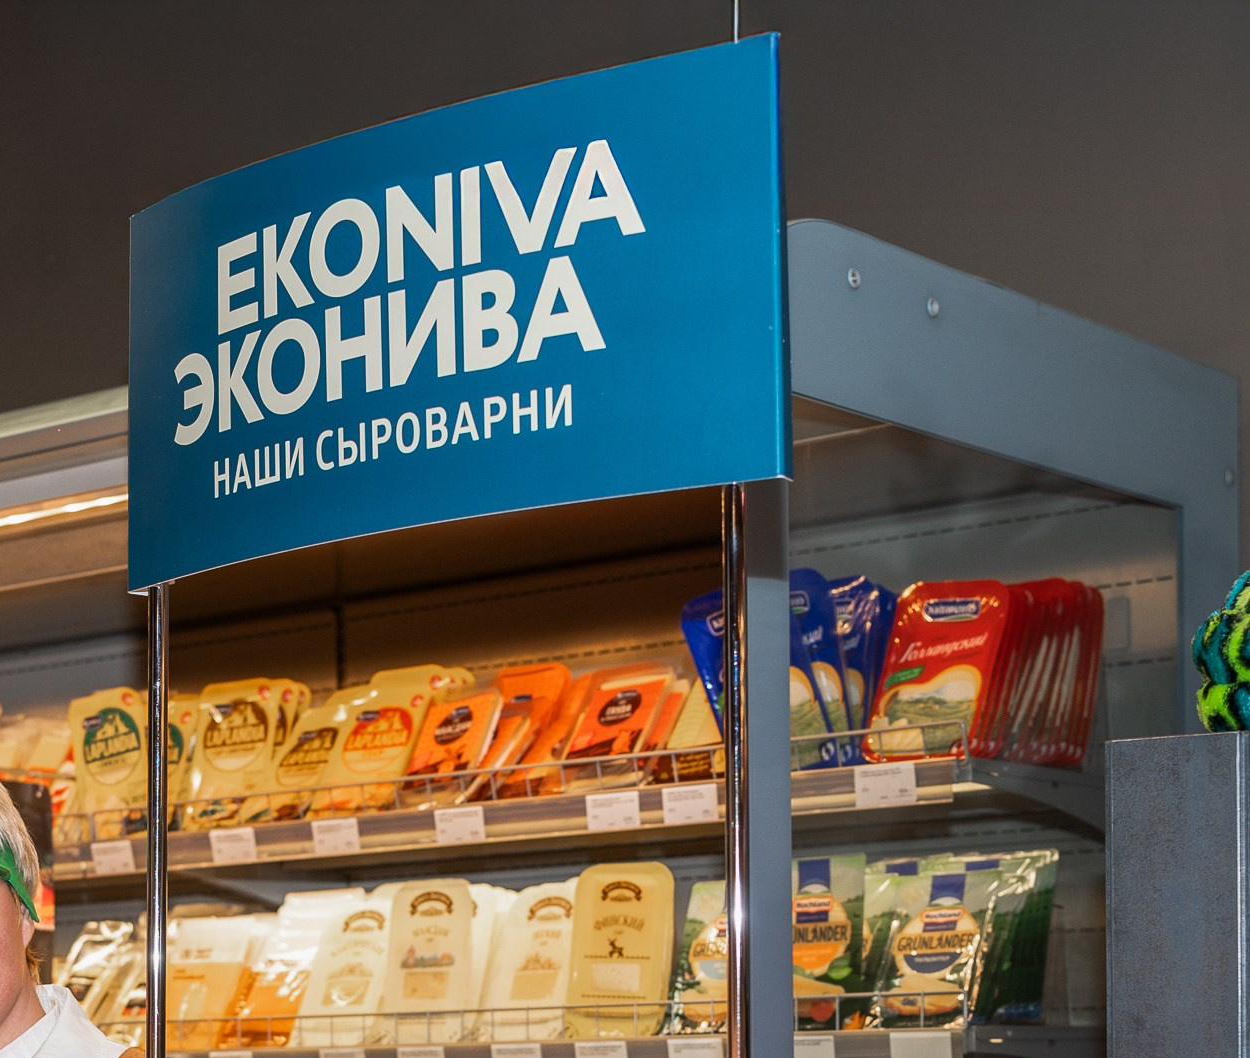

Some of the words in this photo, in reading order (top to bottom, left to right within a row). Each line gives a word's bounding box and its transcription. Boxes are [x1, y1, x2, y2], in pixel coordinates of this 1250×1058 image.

[217, 139, 646, 336] EKONIVA
[173, 255, 607, 446] ЭКОНИВА
[213, 437, 304, 498] НАШИ
[315, 384, 574, 471] СЫРОВАРНИ
